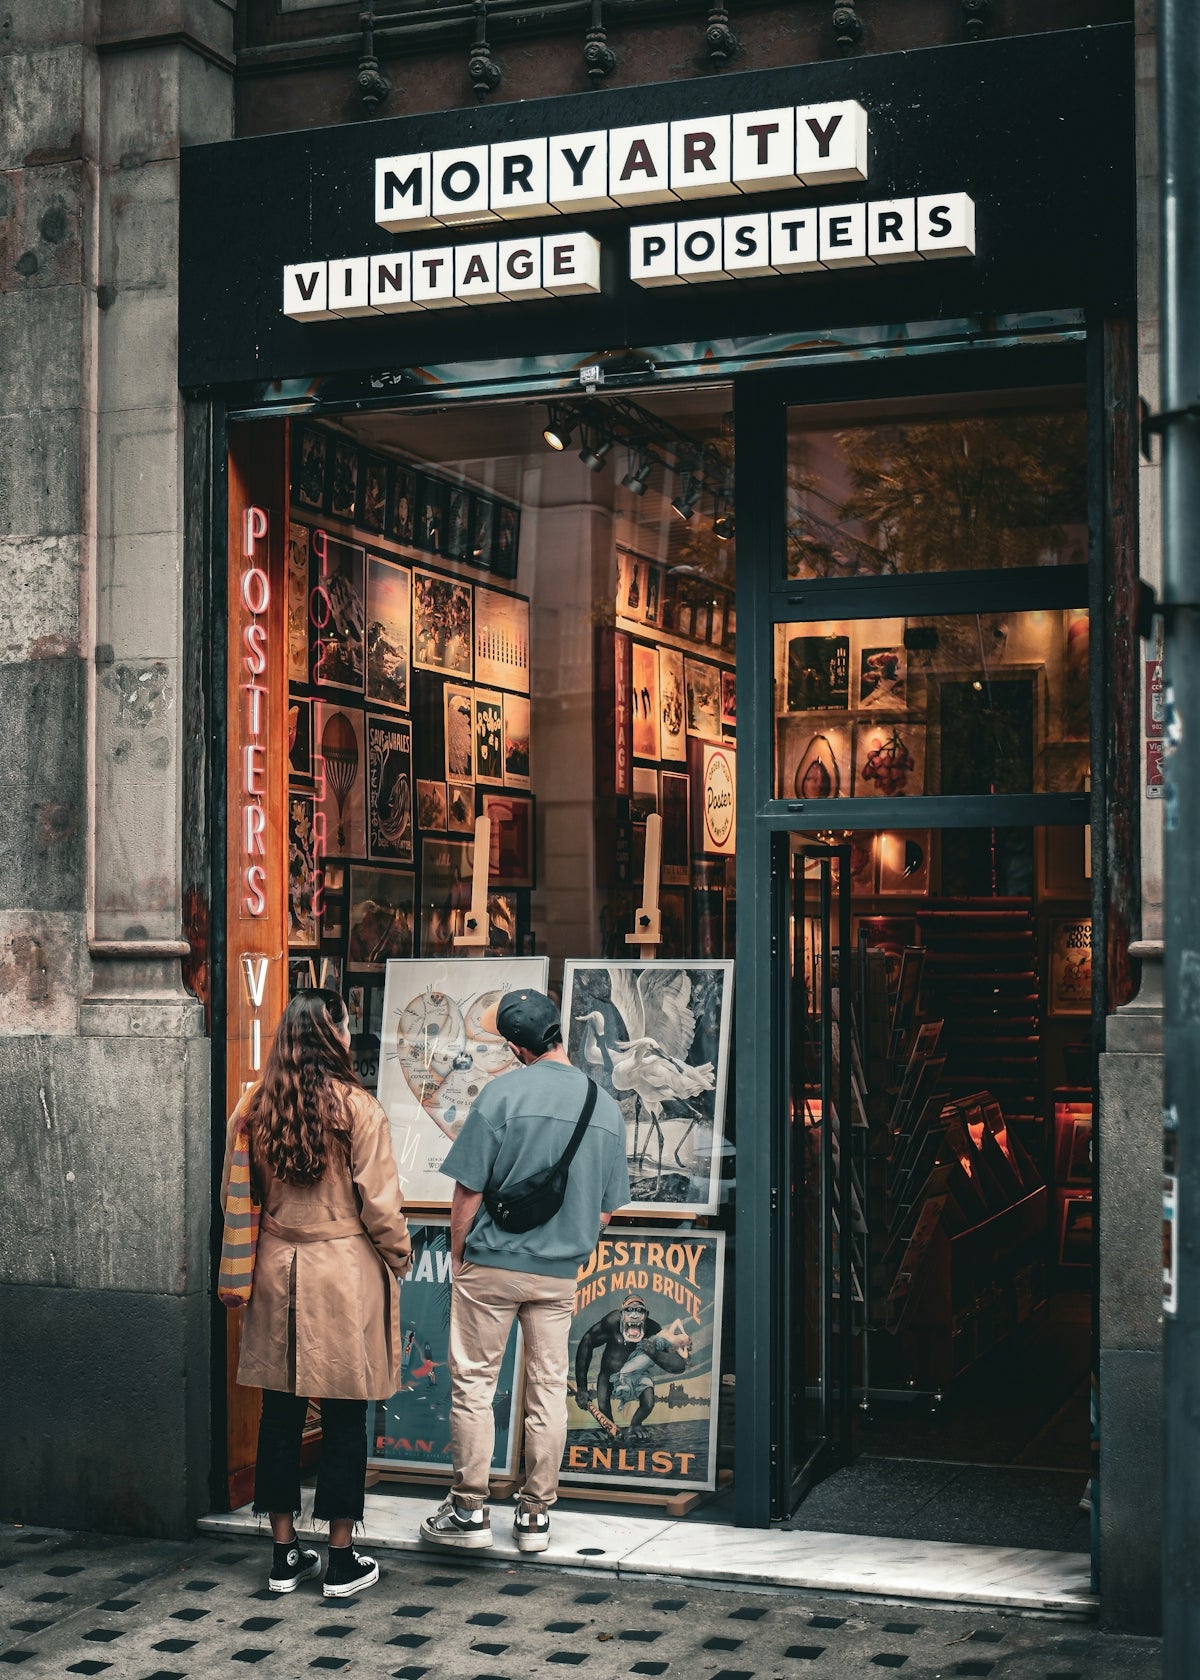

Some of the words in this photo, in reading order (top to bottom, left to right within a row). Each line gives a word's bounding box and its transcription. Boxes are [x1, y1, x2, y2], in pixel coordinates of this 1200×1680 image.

[384, 115, 843, 210] MORYARTY
[294, 244, 576, 301] VINTAGE
[644, 205, 953, 267] POSTERS
[242, 504, 270, 917] POSTERS
[617, 638, 628, 789] VINTAGE
[707, 786, 731, 815] Poster
[610, 1269, 649, 1293] MAD
[652, 1272, 702, 1325] BRUTE
[376, 1436, 434, 1453] PAN
[569, 1445, 696, 1475] ENLIST
